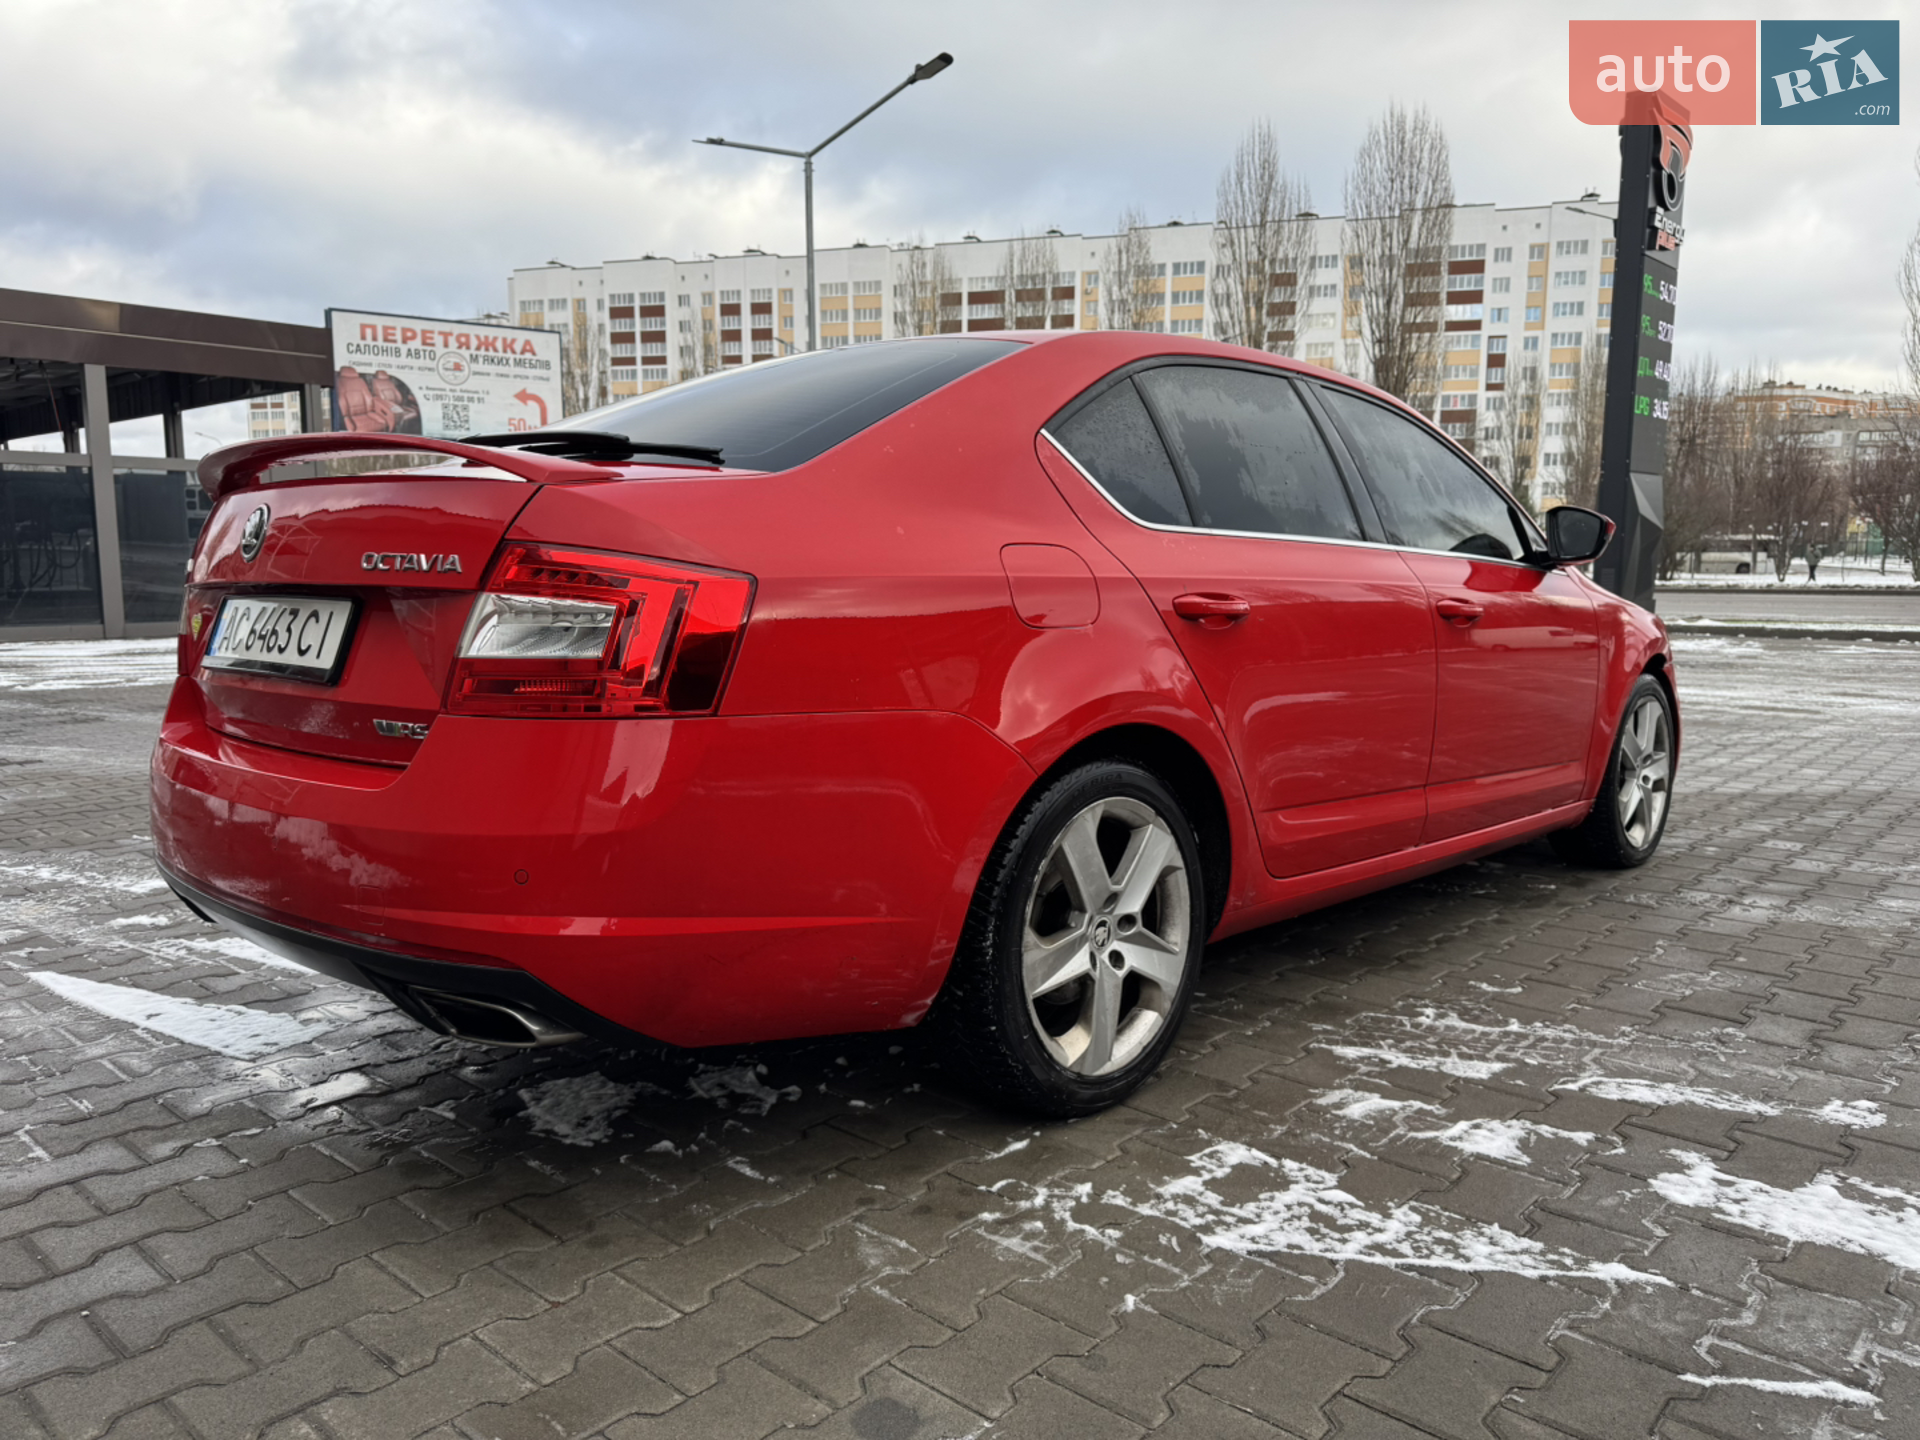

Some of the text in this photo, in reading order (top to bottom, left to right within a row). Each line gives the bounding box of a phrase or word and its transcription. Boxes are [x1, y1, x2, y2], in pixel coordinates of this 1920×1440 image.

[359, 323, 537, 356] ПЕРЕТЯЖКА
[346, 342, 401, 358] САЛОНІВ
[406, 347, 436, 361] АВТО
[513, 358, 552, 370] МЕБЛІВ
[1634, 394, 1650, 416] LPG
[508, 417, 526, 432] 50
[360, 552, 462, 574] OCTAVIA
